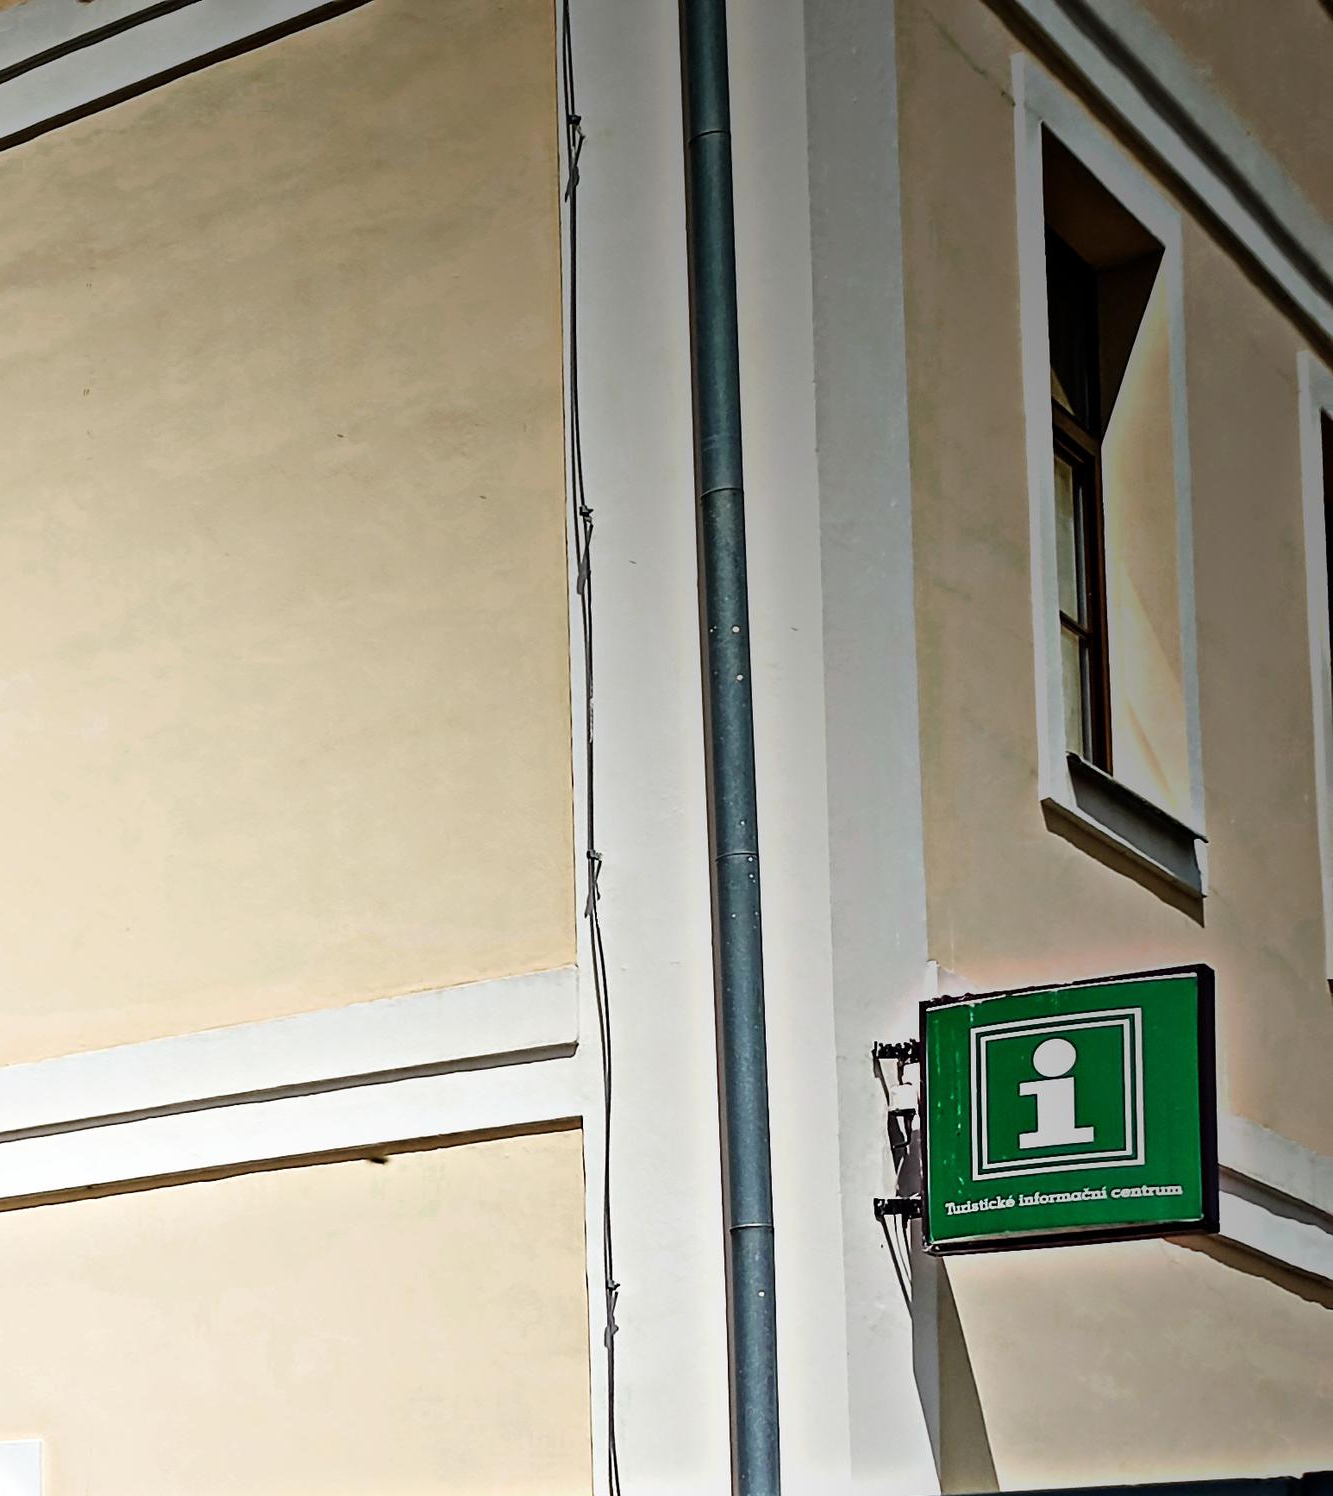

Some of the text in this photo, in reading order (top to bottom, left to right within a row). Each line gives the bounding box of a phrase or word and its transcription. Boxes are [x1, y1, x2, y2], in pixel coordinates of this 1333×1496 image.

[944, 1183, 1183, 1216] Turistické informační centrum
